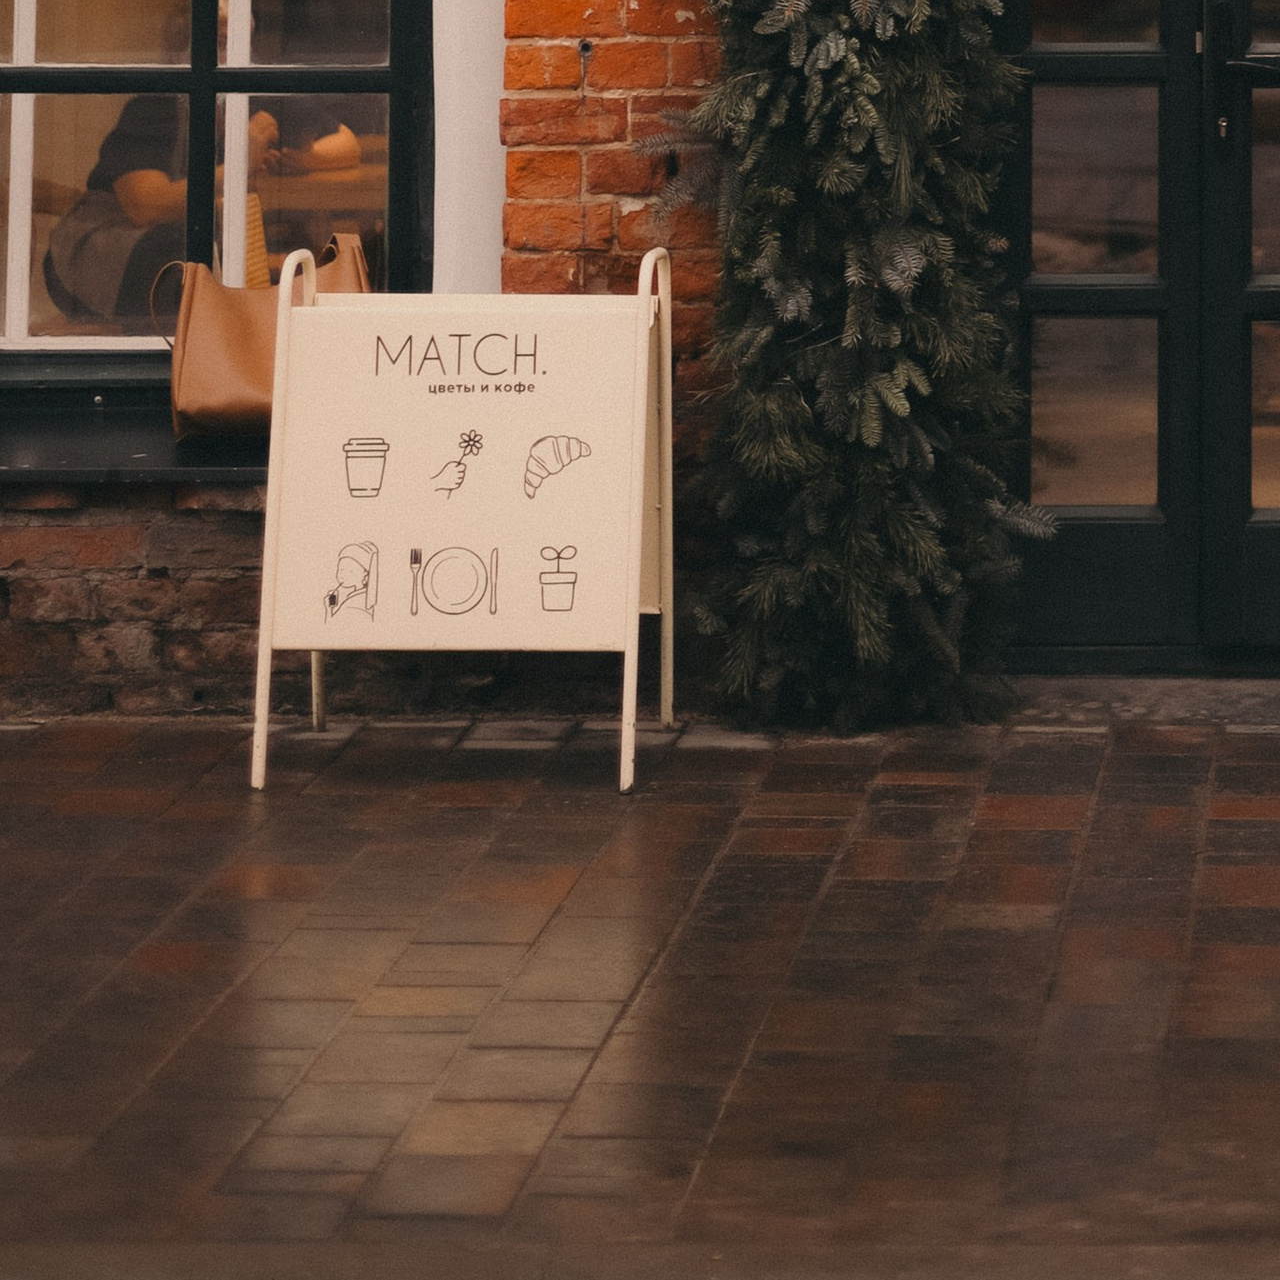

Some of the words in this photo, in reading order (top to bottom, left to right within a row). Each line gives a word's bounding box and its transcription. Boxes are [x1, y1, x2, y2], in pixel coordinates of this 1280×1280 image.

[375, 332, 547, 377] MATCH.
[428, 383, 476, 395] цветы
[480, 383, 489, 393] и
[494, 381, 536, 395] кофе
